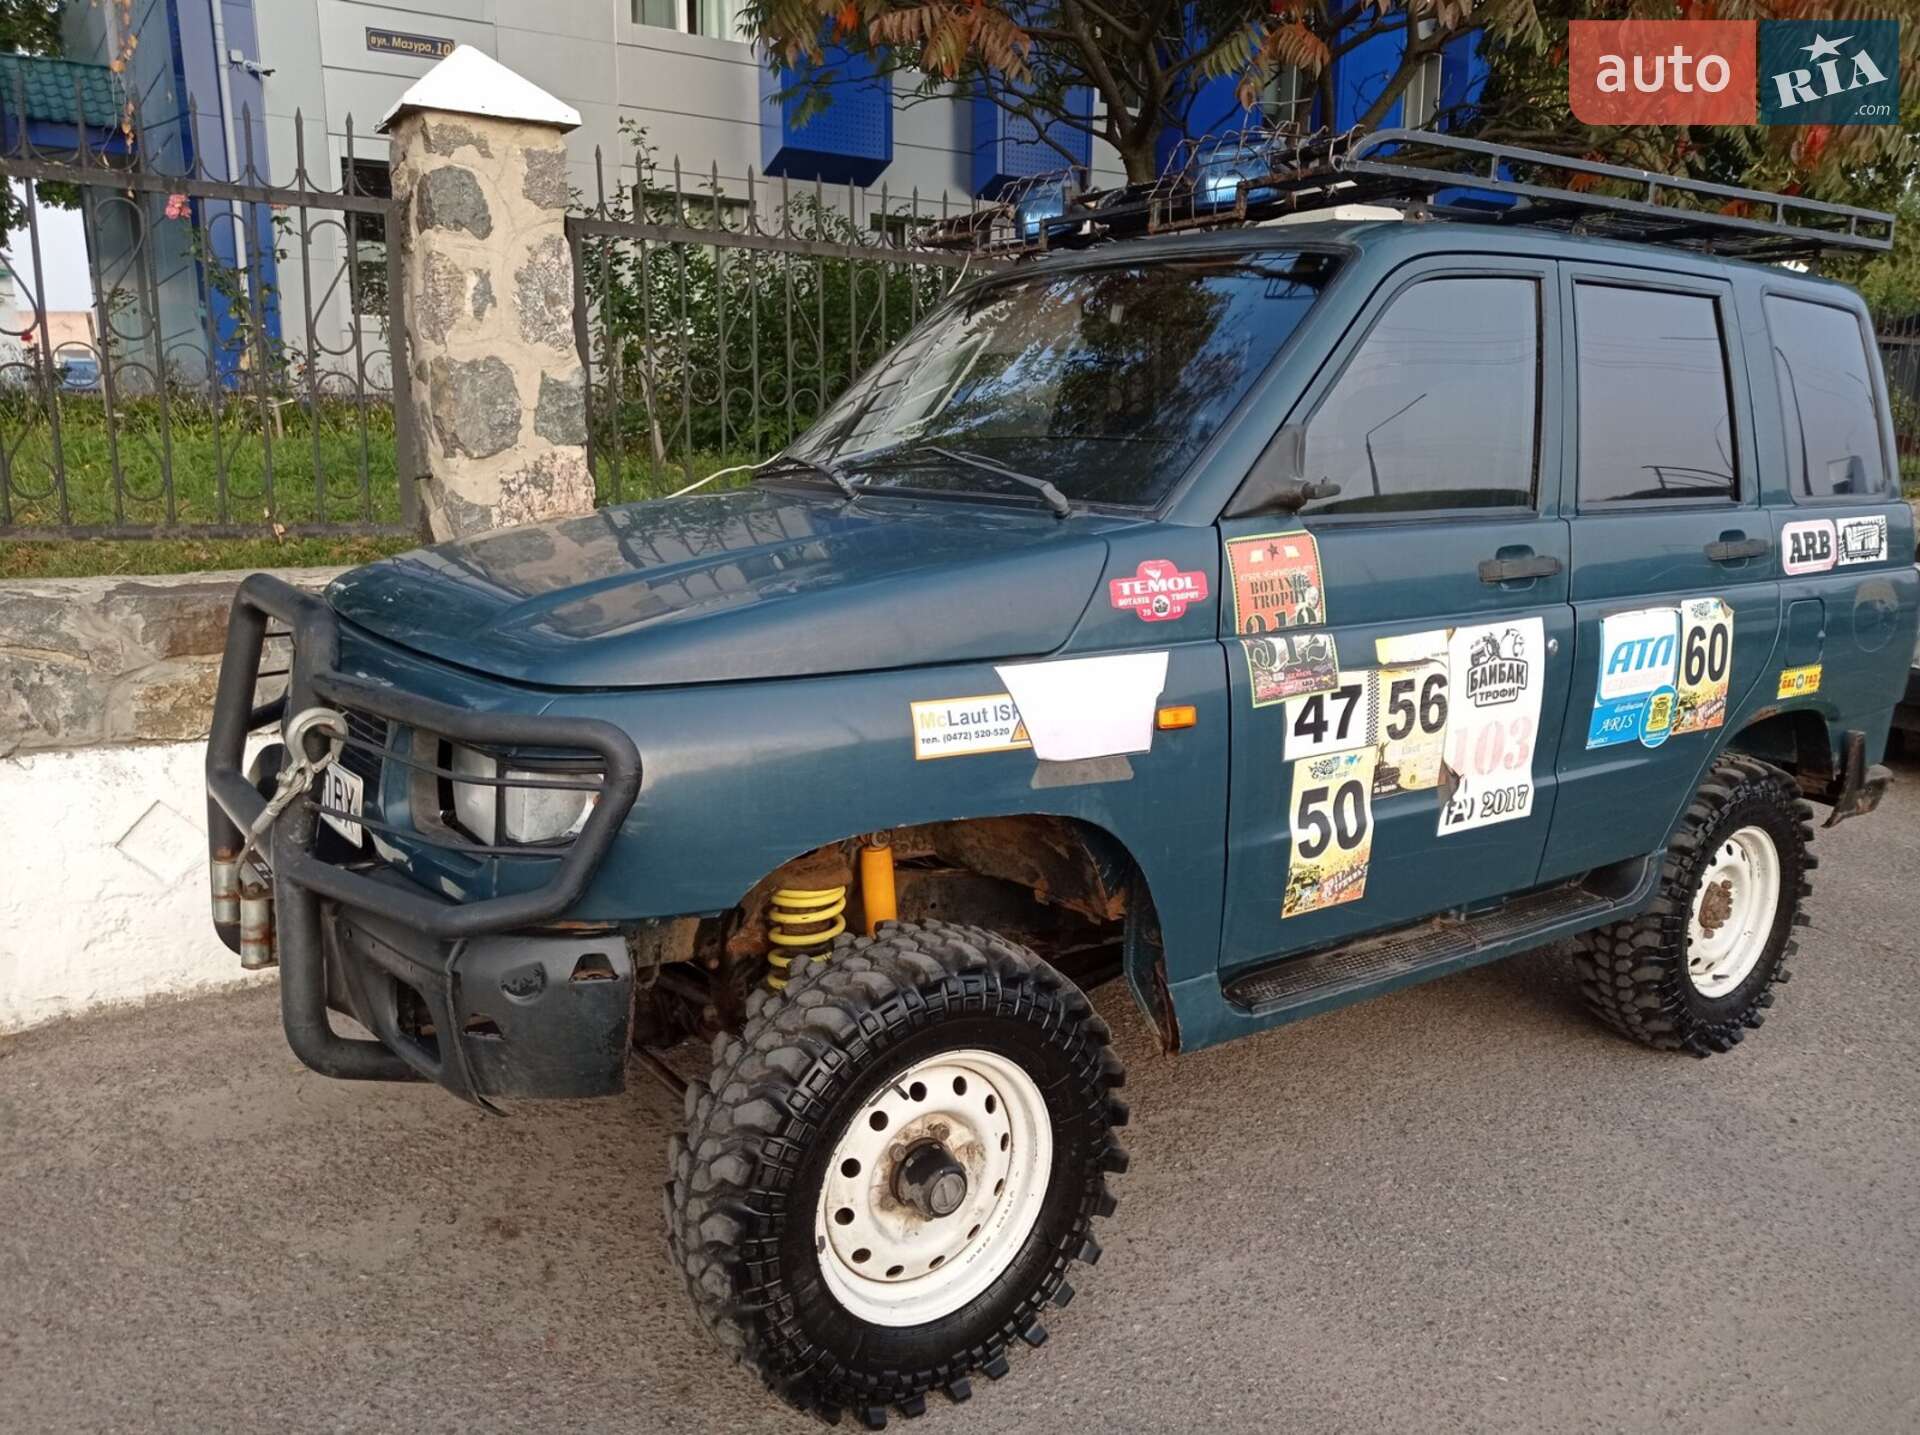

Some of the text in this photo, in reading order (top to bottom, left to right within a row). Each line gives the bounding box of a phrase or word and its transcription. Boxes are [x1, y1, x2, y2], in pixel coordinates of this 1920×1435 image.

[392, 36, 434, 54] Мазура,
[437, 42, 451, 56] 10
[1789, 529, 1832, 564] ARB
[1119, 576, 1199, 595] TEMOL
[1685, 623, 1729, 686] 60
[1386, 673, 1449, 741] 56
[1478, 686, 1516, 701] ТРОФИ
[1294, 684, 1363, 744] 47
[943, 731, 972, 744] (0472)
[975, 727, 1010, 739] 520-520
[1480, 784, 1529, 818] 2017
[1298, 779, 1368, 860] 50
